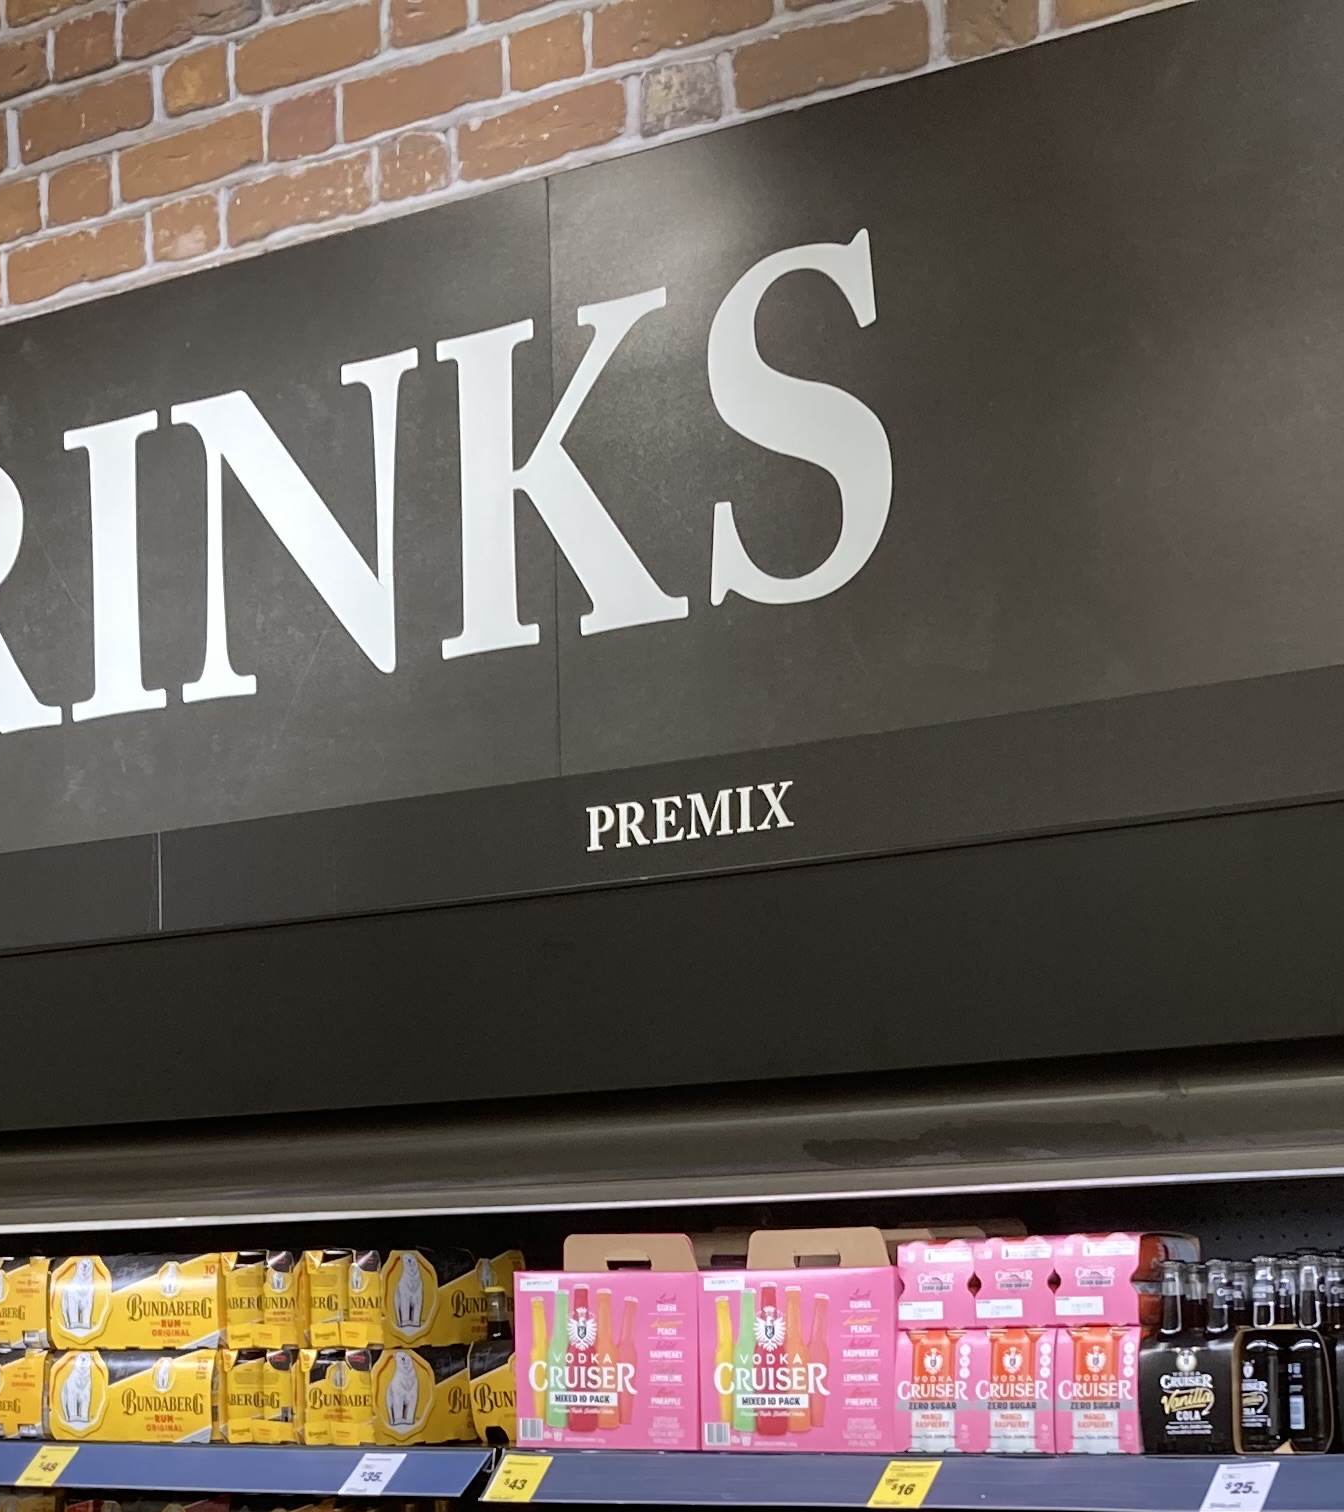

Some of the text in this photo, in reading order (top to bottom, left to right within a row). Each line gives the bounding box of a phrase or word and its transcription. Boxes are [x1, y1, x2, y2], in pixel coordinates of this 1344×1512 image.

[587, 781, 794, 851] PREMIX
[553, 1353, 613, 1365] VODKA
[740, 1353, 802, 1365] VODKA
[528, 1361, 638, 1396] CRUISER
[714, 1361, 830, 1397] CRUISER
[554, 1394, 577, 1404] MIXED
[587, 1394, 611, 1405] PACK
[1058, 1379, 1132, 1401] CRUISER
[1161, 1389, 1216, 1413] Vanilla
[121, 1388, 204, 1417] BUNDABERG
[1175, 1410, 1203, 1422] COLA
[504, 1478, 528, 1491] $43
